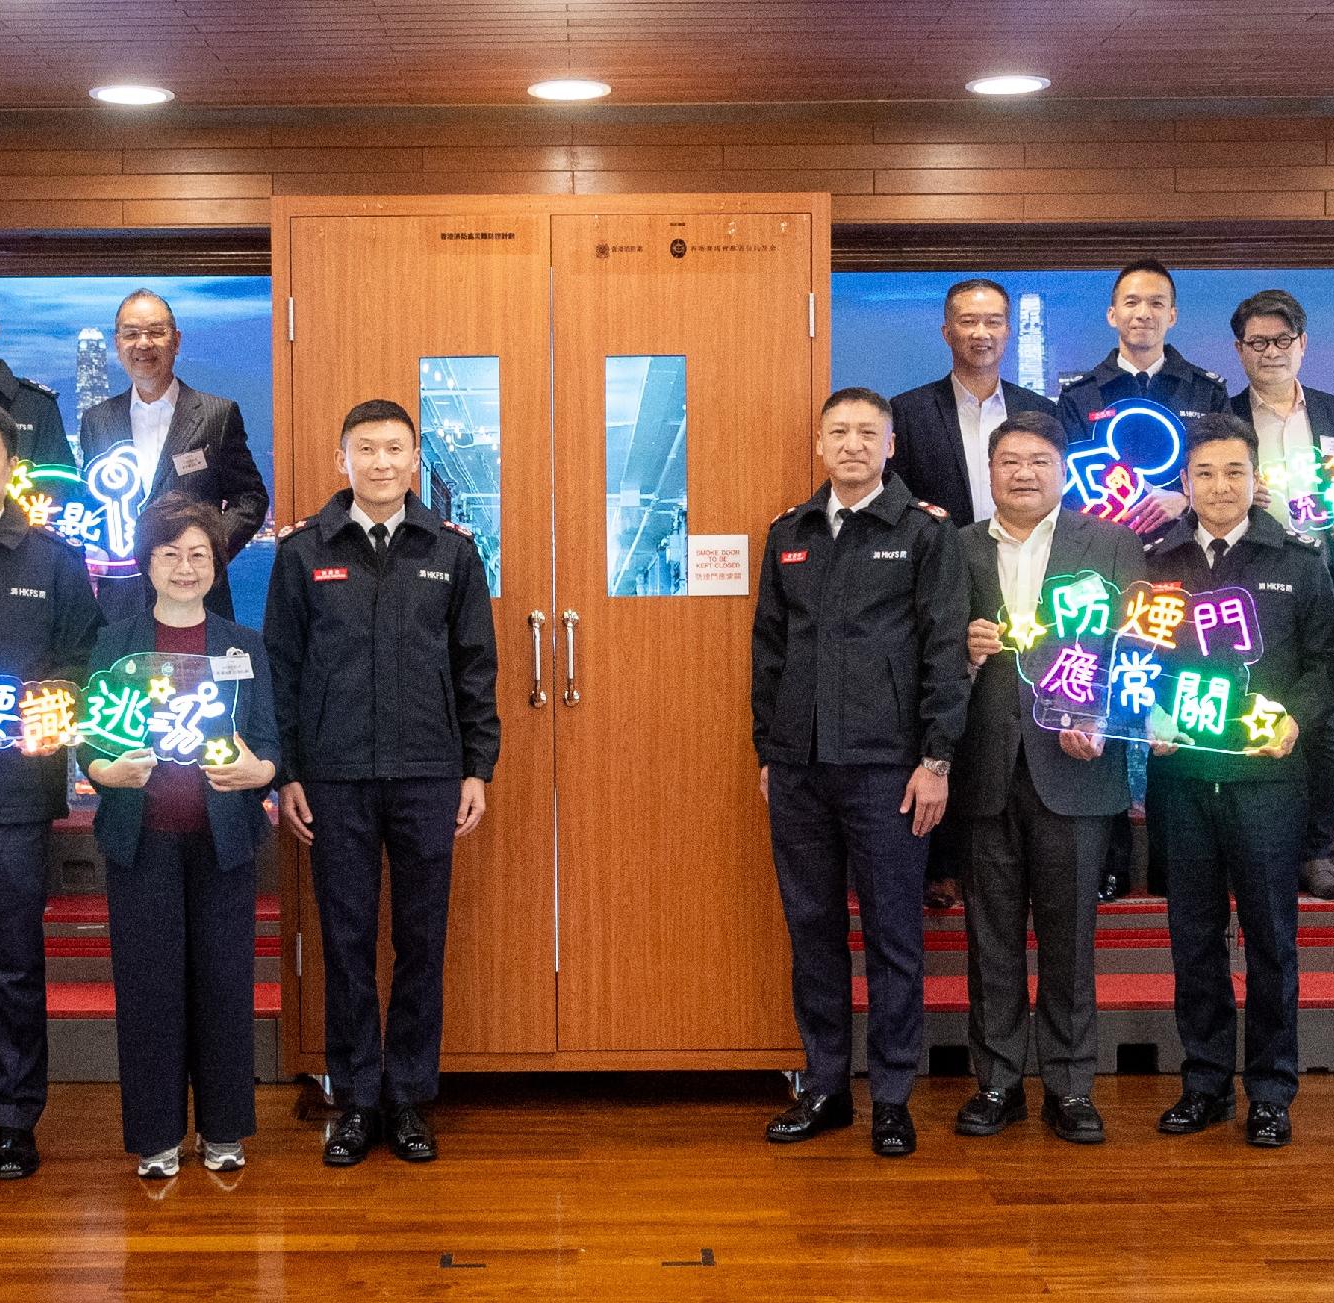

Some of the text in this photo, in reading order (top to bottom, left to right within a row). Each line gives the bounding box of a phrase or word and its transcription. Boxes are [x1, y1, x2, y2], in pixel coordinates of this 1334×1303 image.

[880, 551, 900, 559] HKFS
[1266, 582, 1286, 591] HKFS
[19, 587, 39, 598] HKFS
[1053, 587, 1253, 656] 防煙門
[1040, 644, 1232, 735] 應常關
